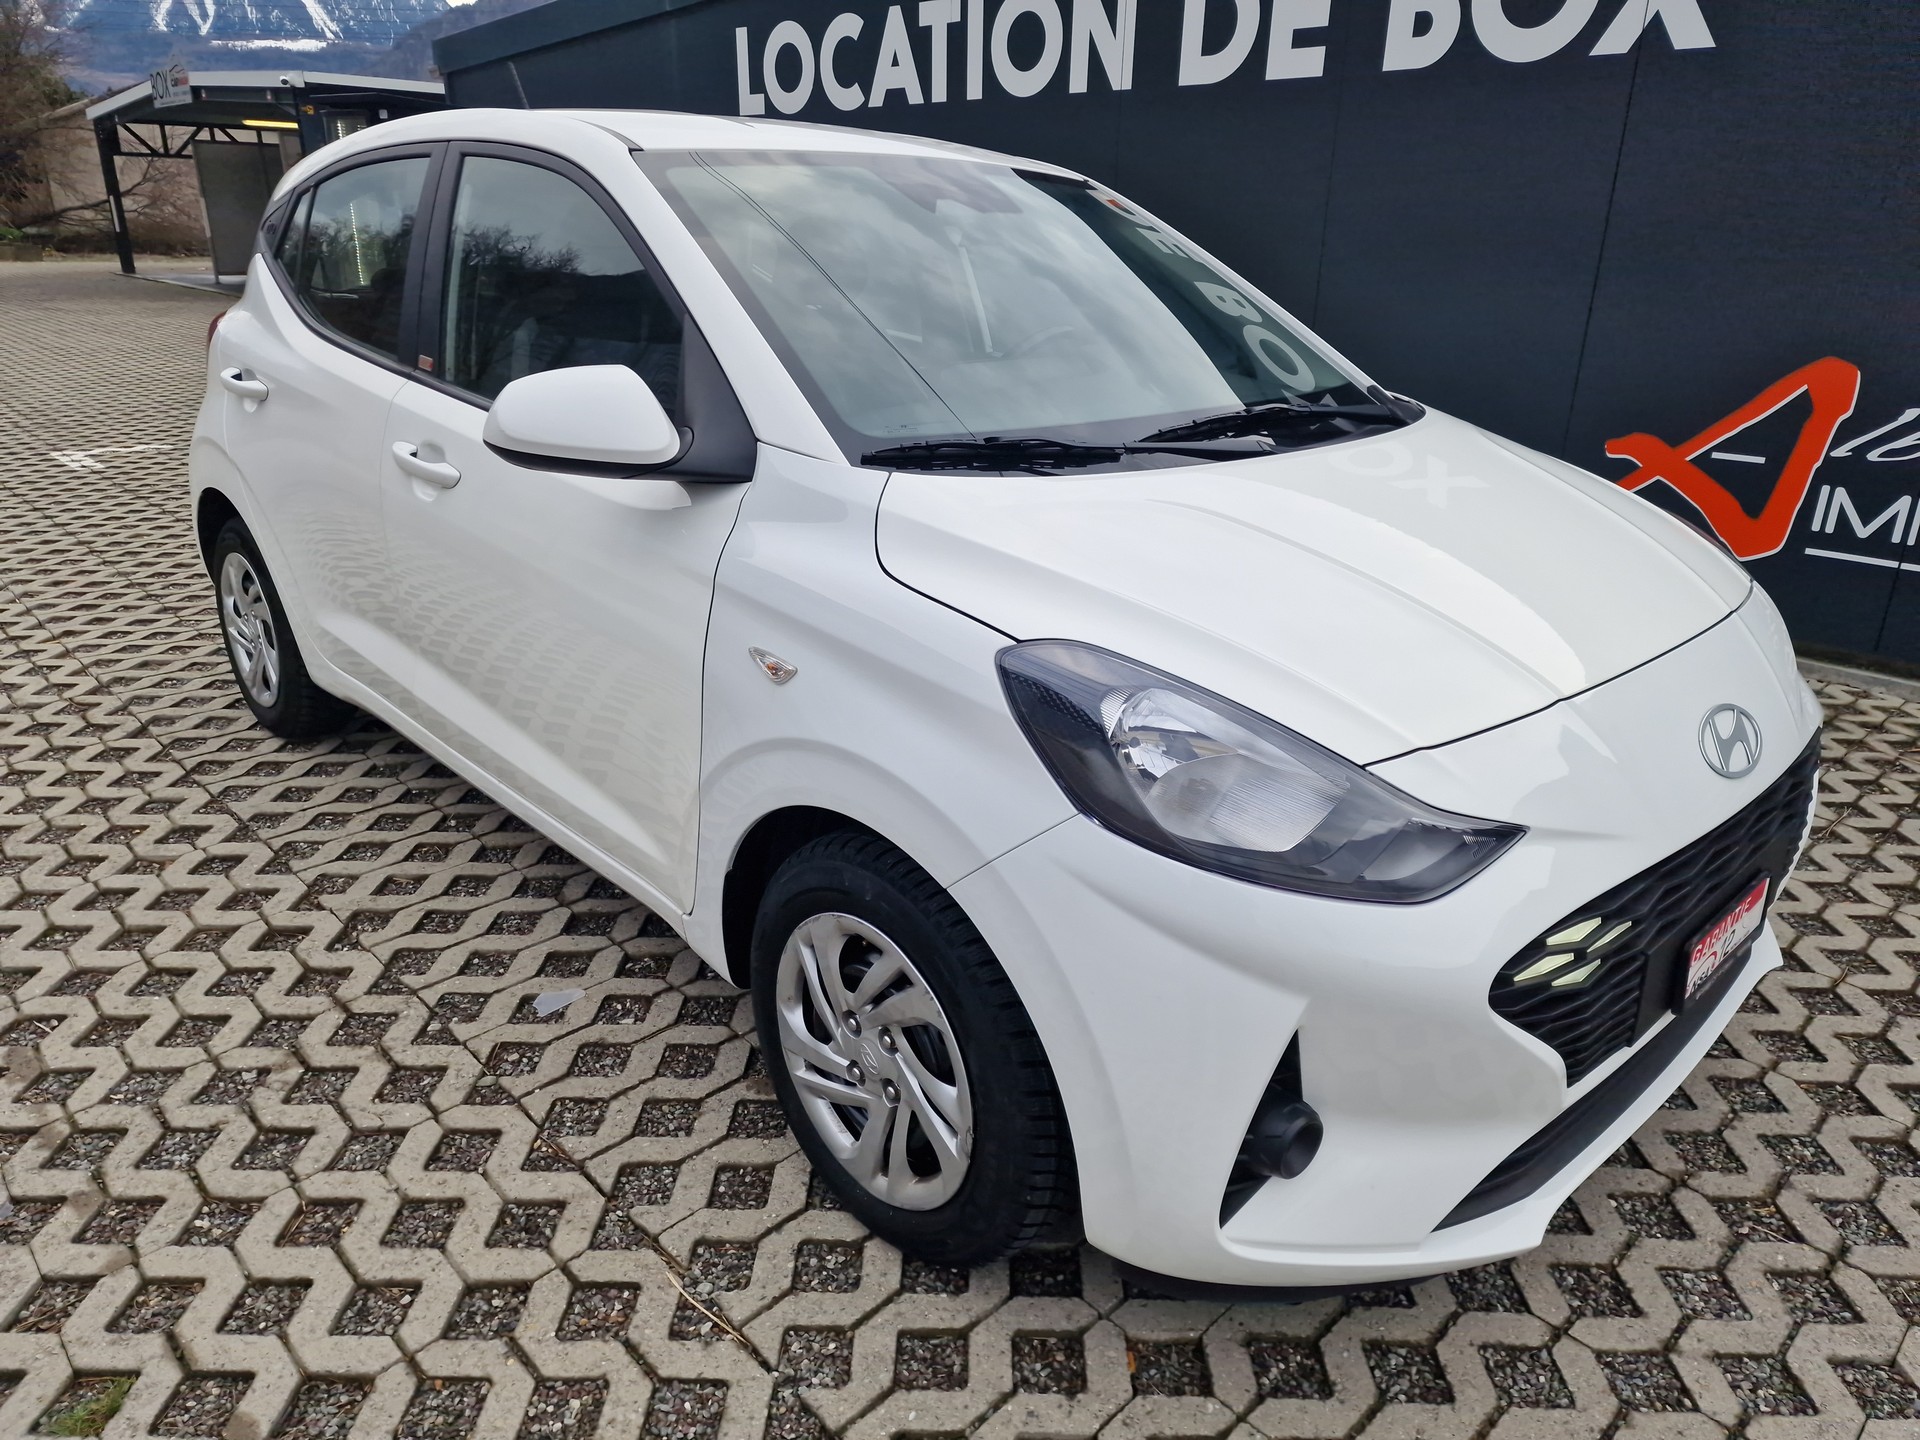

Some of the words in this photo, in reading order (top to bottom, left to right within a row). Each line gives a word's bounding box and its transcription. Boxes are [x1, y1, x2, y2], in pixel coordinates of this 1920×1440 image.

[149, 69, 171, 100] BOX
[736, 0, 1139, 116] LOCATION
[1811, 484, 1920, 546] IM
[1691, 896, 1752, 966] GARANTIE
